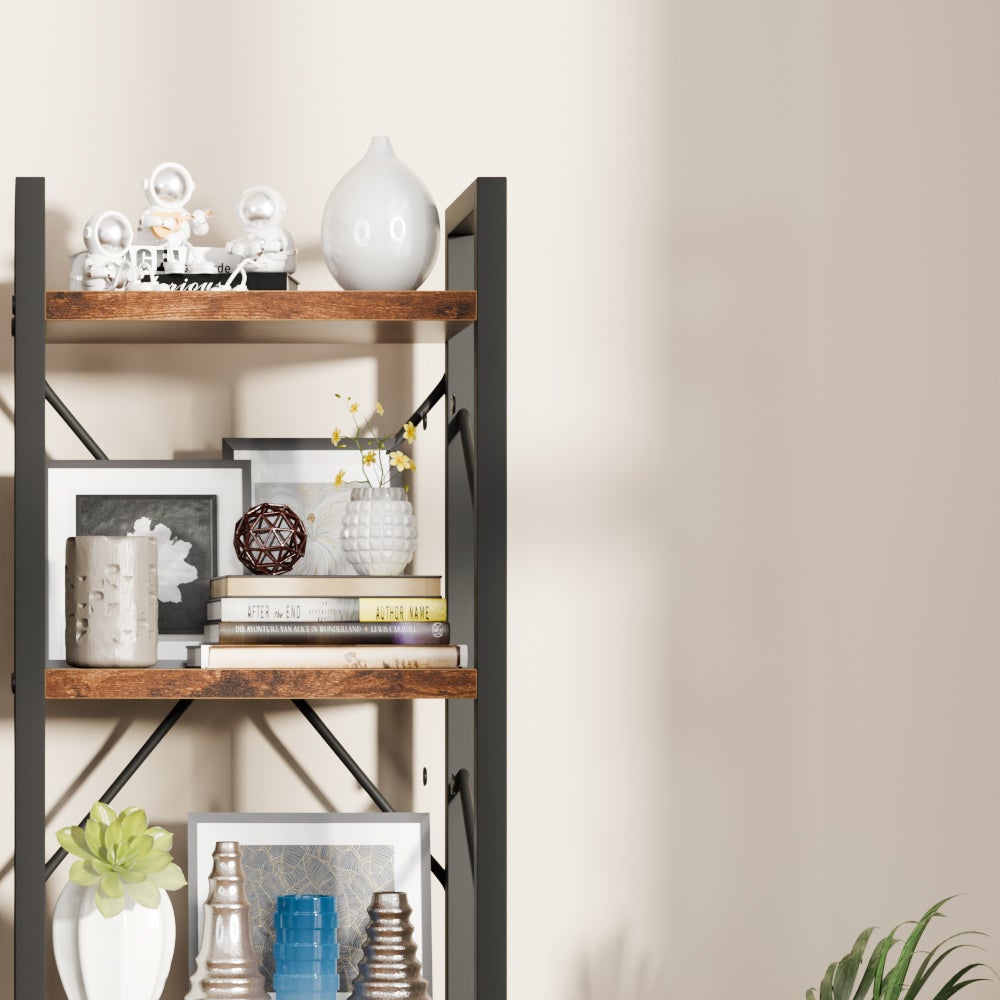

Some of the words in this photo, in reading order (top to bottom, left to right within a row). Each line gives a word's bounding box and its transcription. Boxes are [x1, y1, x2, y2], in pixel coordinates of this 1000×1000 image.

[247, 605, 270, 619] AFTER
[274, 610, 283, 619] the
[286, 605, 301, 619] END
[376, 605, 404, 620] AUTHOR
[409, 605, 430, 620] NAME
[279, 625, 294, 633] VAN
[294, 625, 311, 633] ALICE
[311, 625, 318, 633] IN
[318, 625, 362, 633] WONDERLAND
[370, 625, 390, 633] LEWIS
